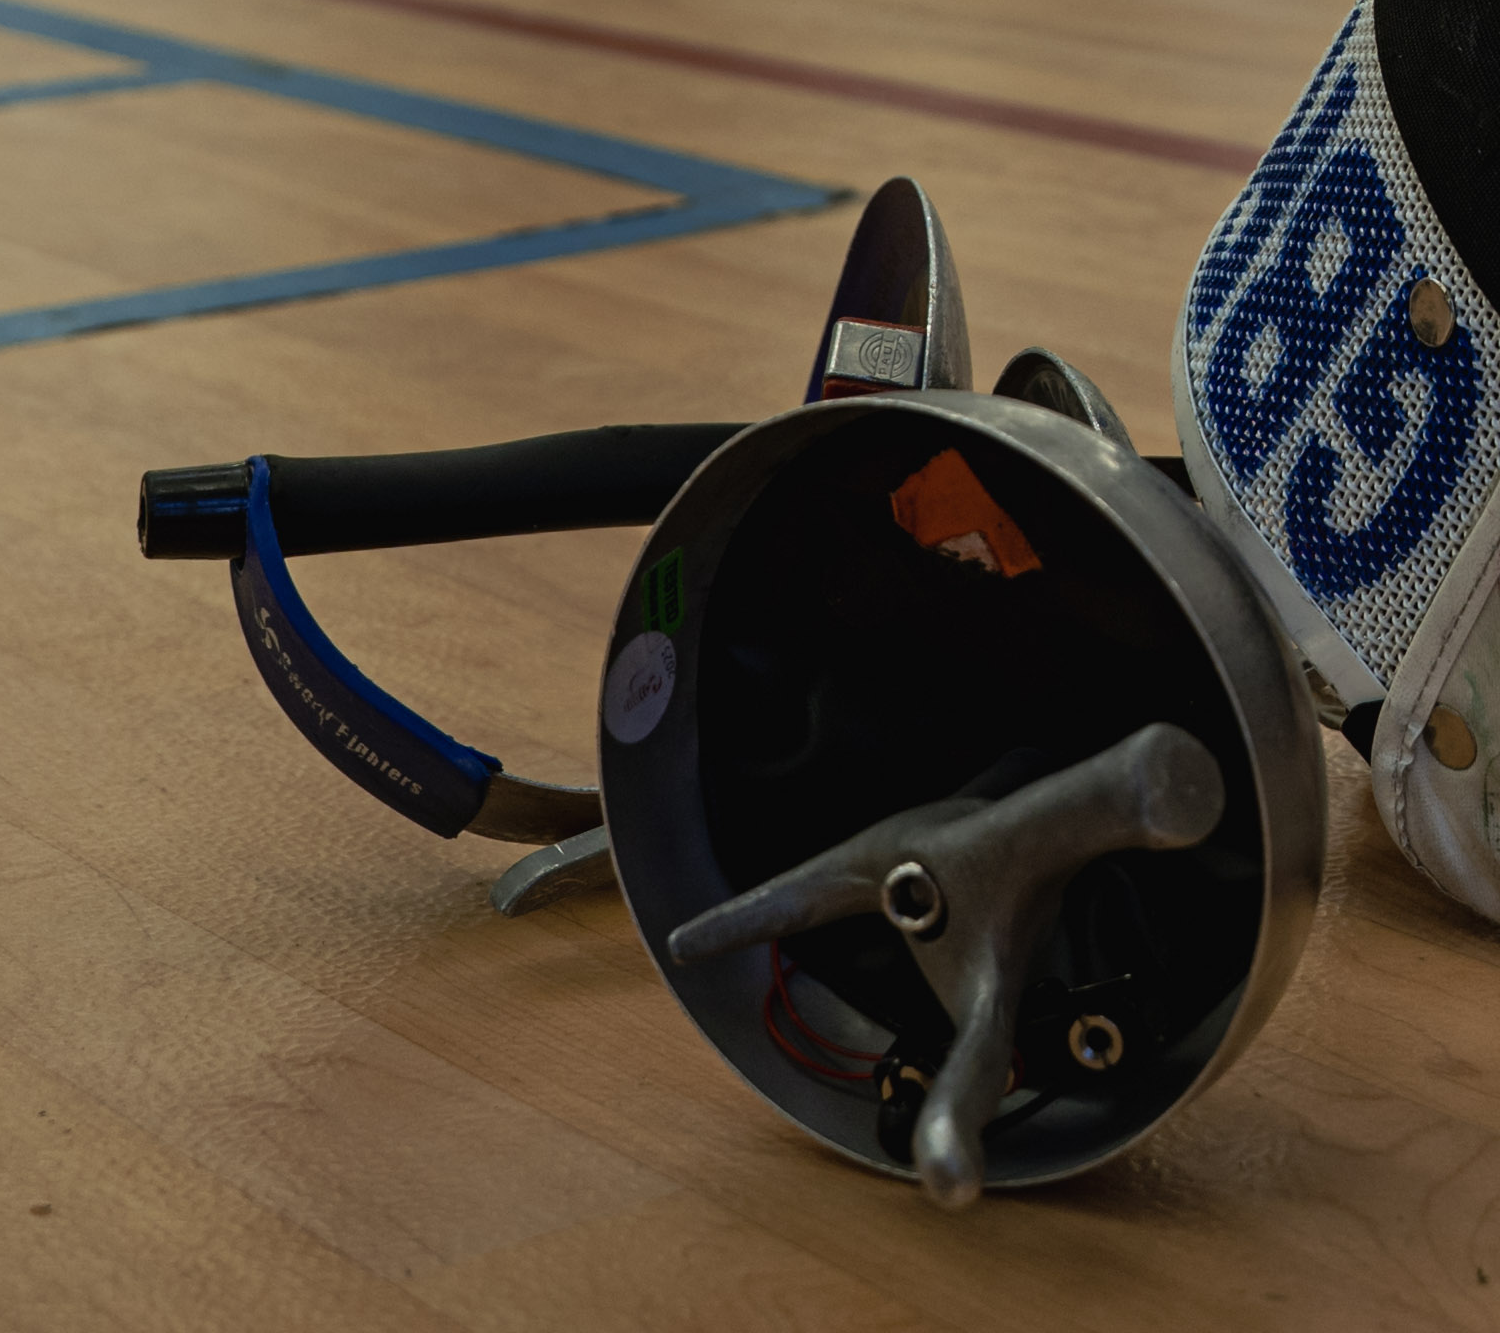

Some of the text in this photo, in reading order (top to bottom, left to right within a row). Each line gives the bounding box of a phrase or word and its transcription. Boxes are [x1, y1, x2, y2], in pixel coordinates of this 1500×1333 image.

[1194, 8, 1481, 599] GBR
[877, 339, 895, 375] PAUL
[665, 558, 679, 623] TESTED
[336, 720, 423, 796] Fighters
